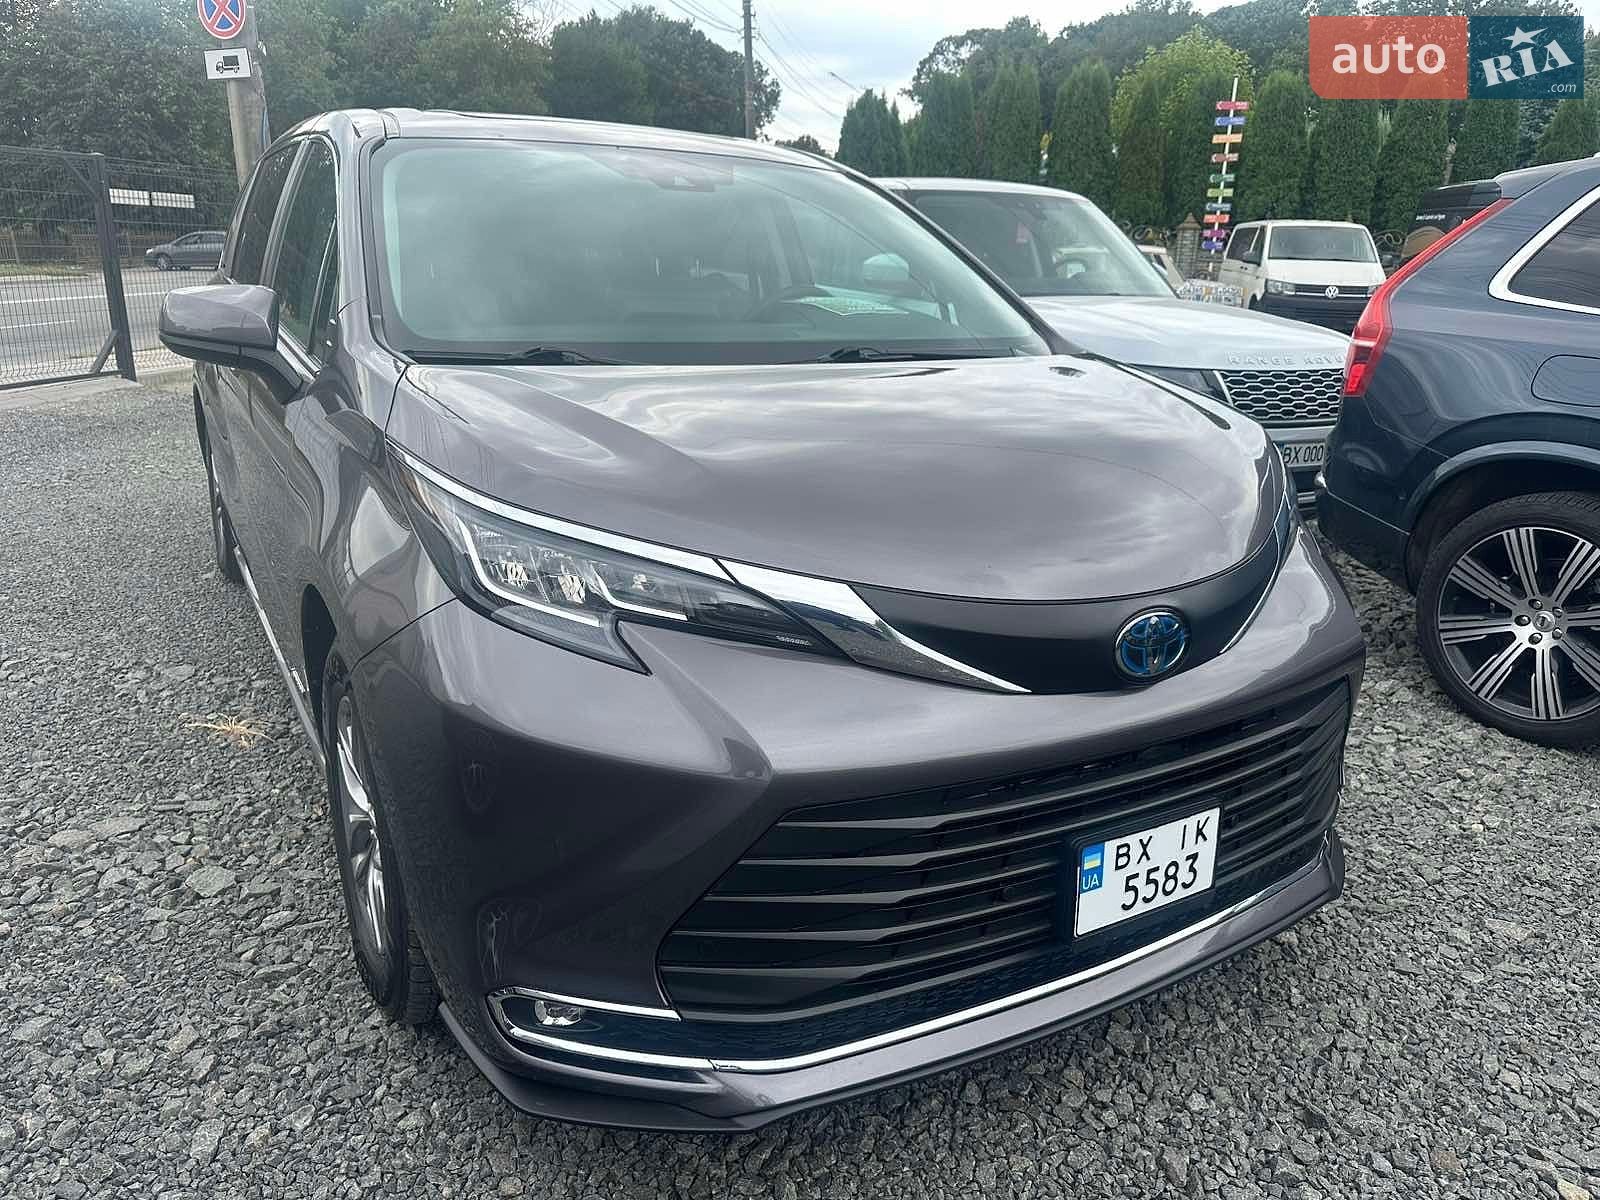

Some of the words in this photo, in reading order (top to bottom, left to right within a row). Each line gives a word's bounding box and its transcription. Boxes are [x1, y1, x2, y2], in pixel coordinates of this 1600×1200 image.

[1226, 353, 1295, 366] RANGE
[1114, 835, 1153, 871] BX
[1180, 815, 1211, 851] IK
[1082, 876, 1100, 890] UA
[1120, 852, 1200, 911] 5583
